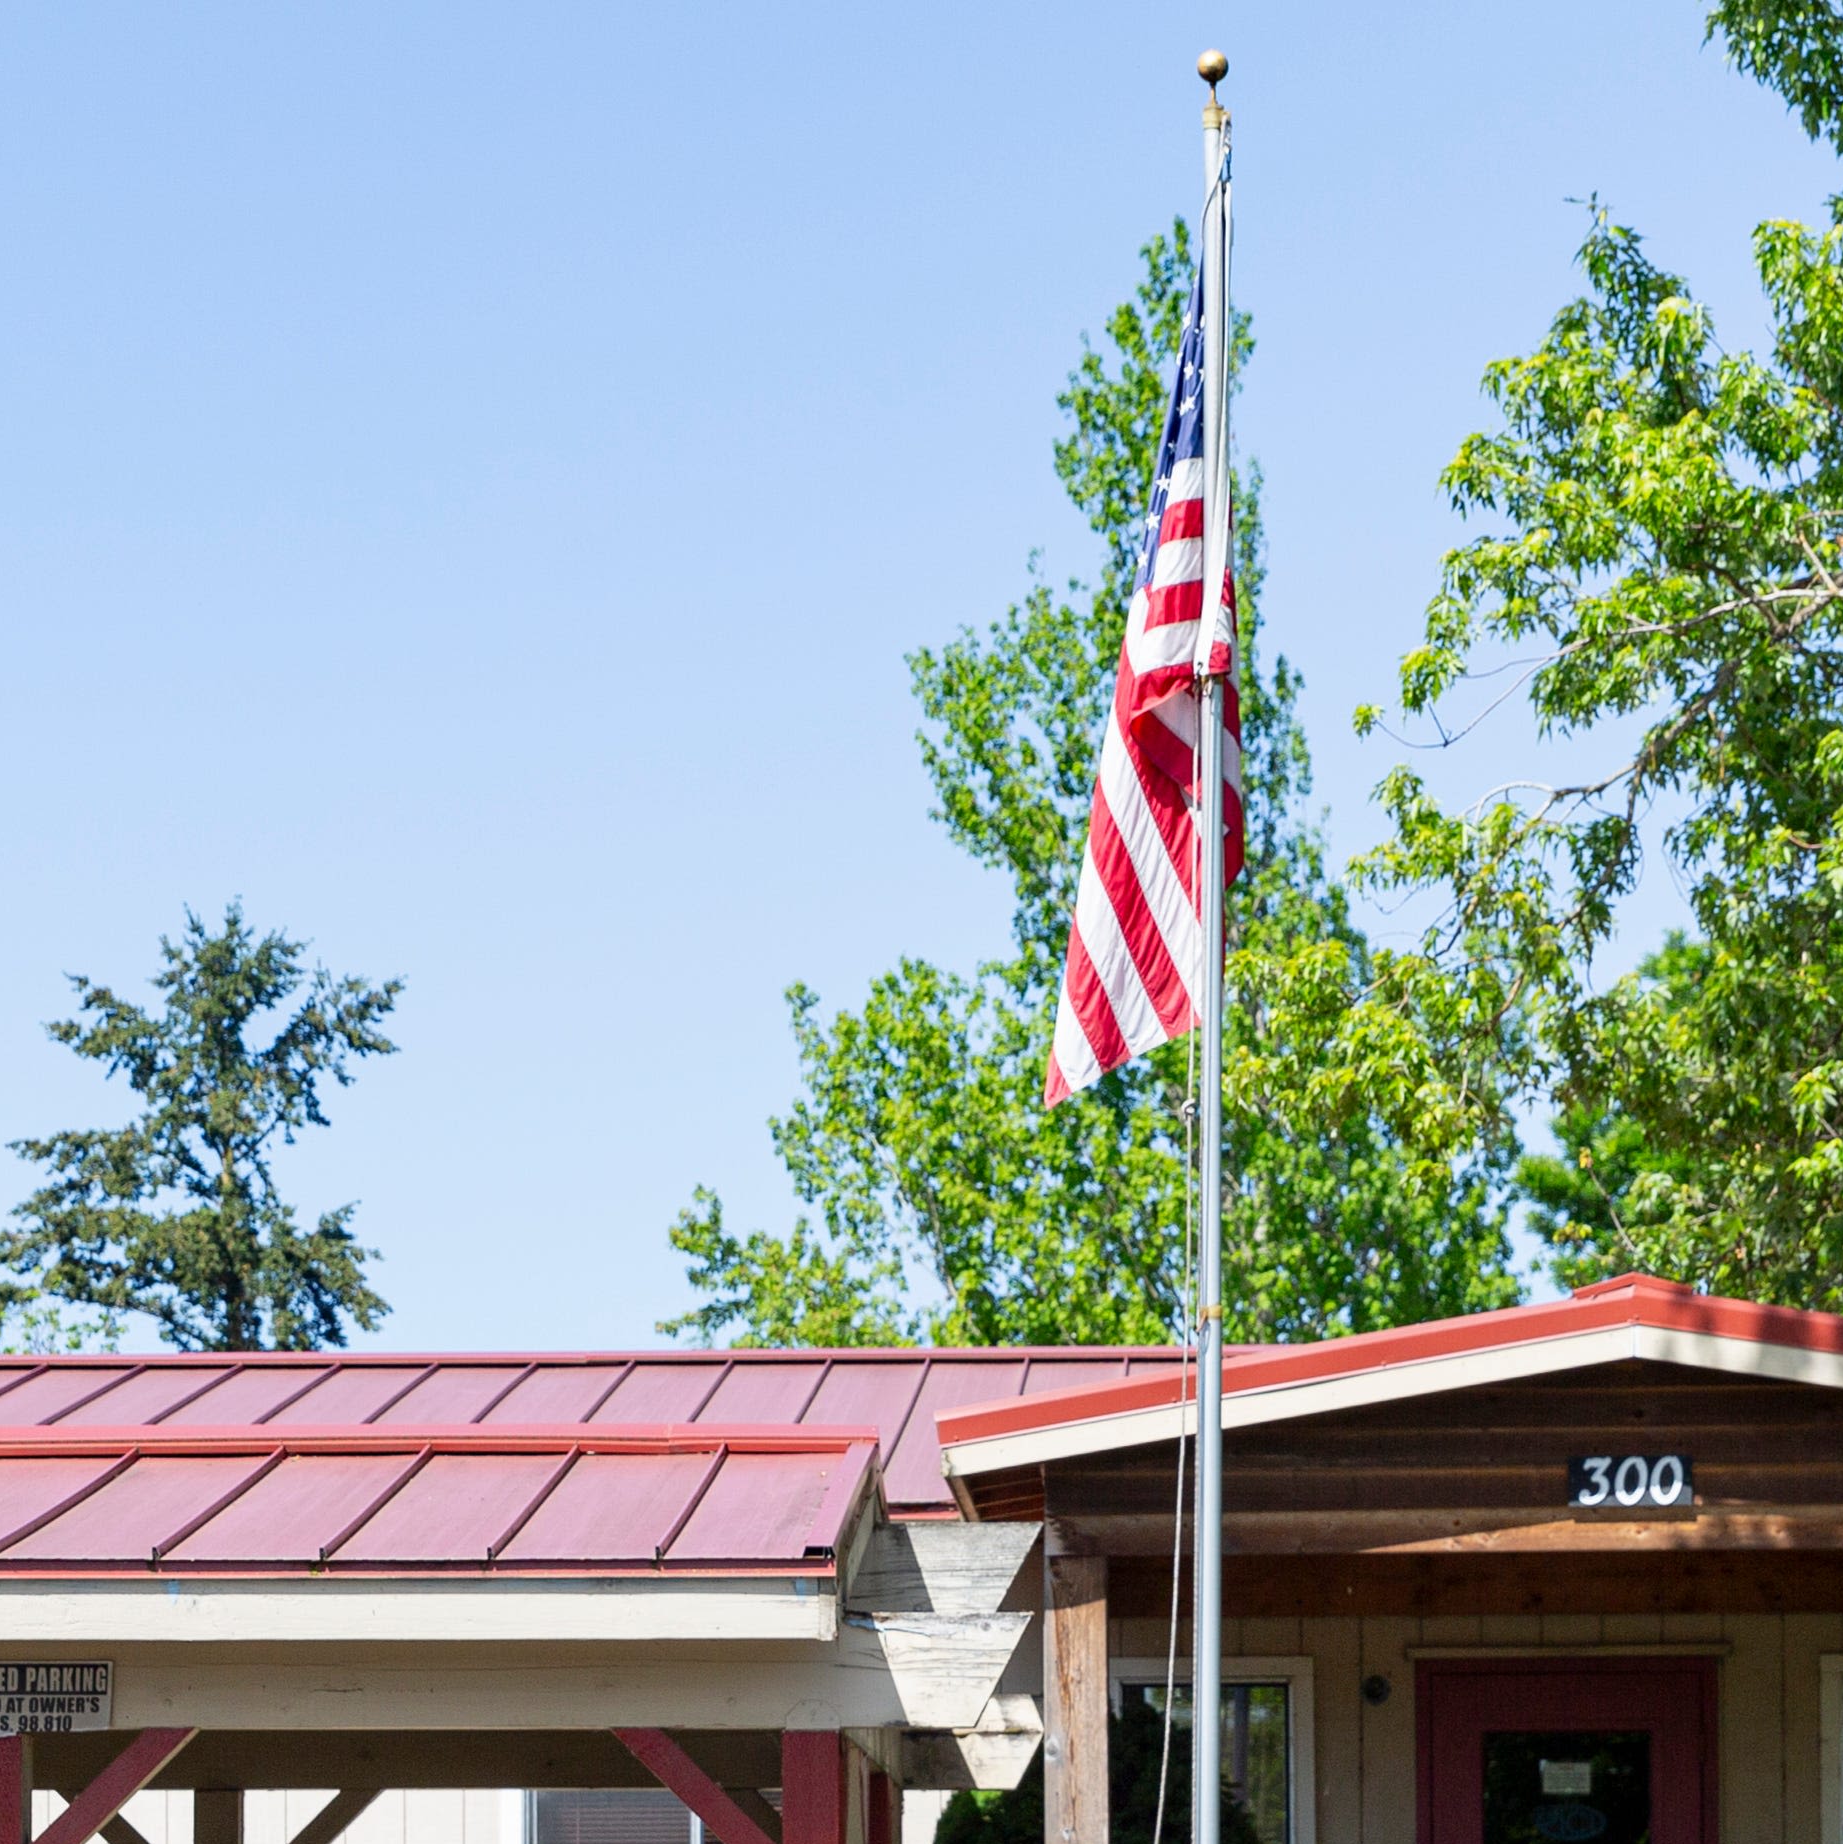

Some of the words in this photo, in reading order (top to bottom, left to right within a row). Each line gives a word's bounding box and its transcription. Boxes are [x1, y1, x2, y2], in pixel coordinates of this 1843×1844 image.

[1578, 1454, 1684, 1506] 300
[25, 1666, 107, 1692] PARKING
[6, 1696, 25, 1713] AT
[28, 1696, 100, 1713] OWNER'S
[18, 1714, 72, 1732] 98.810
